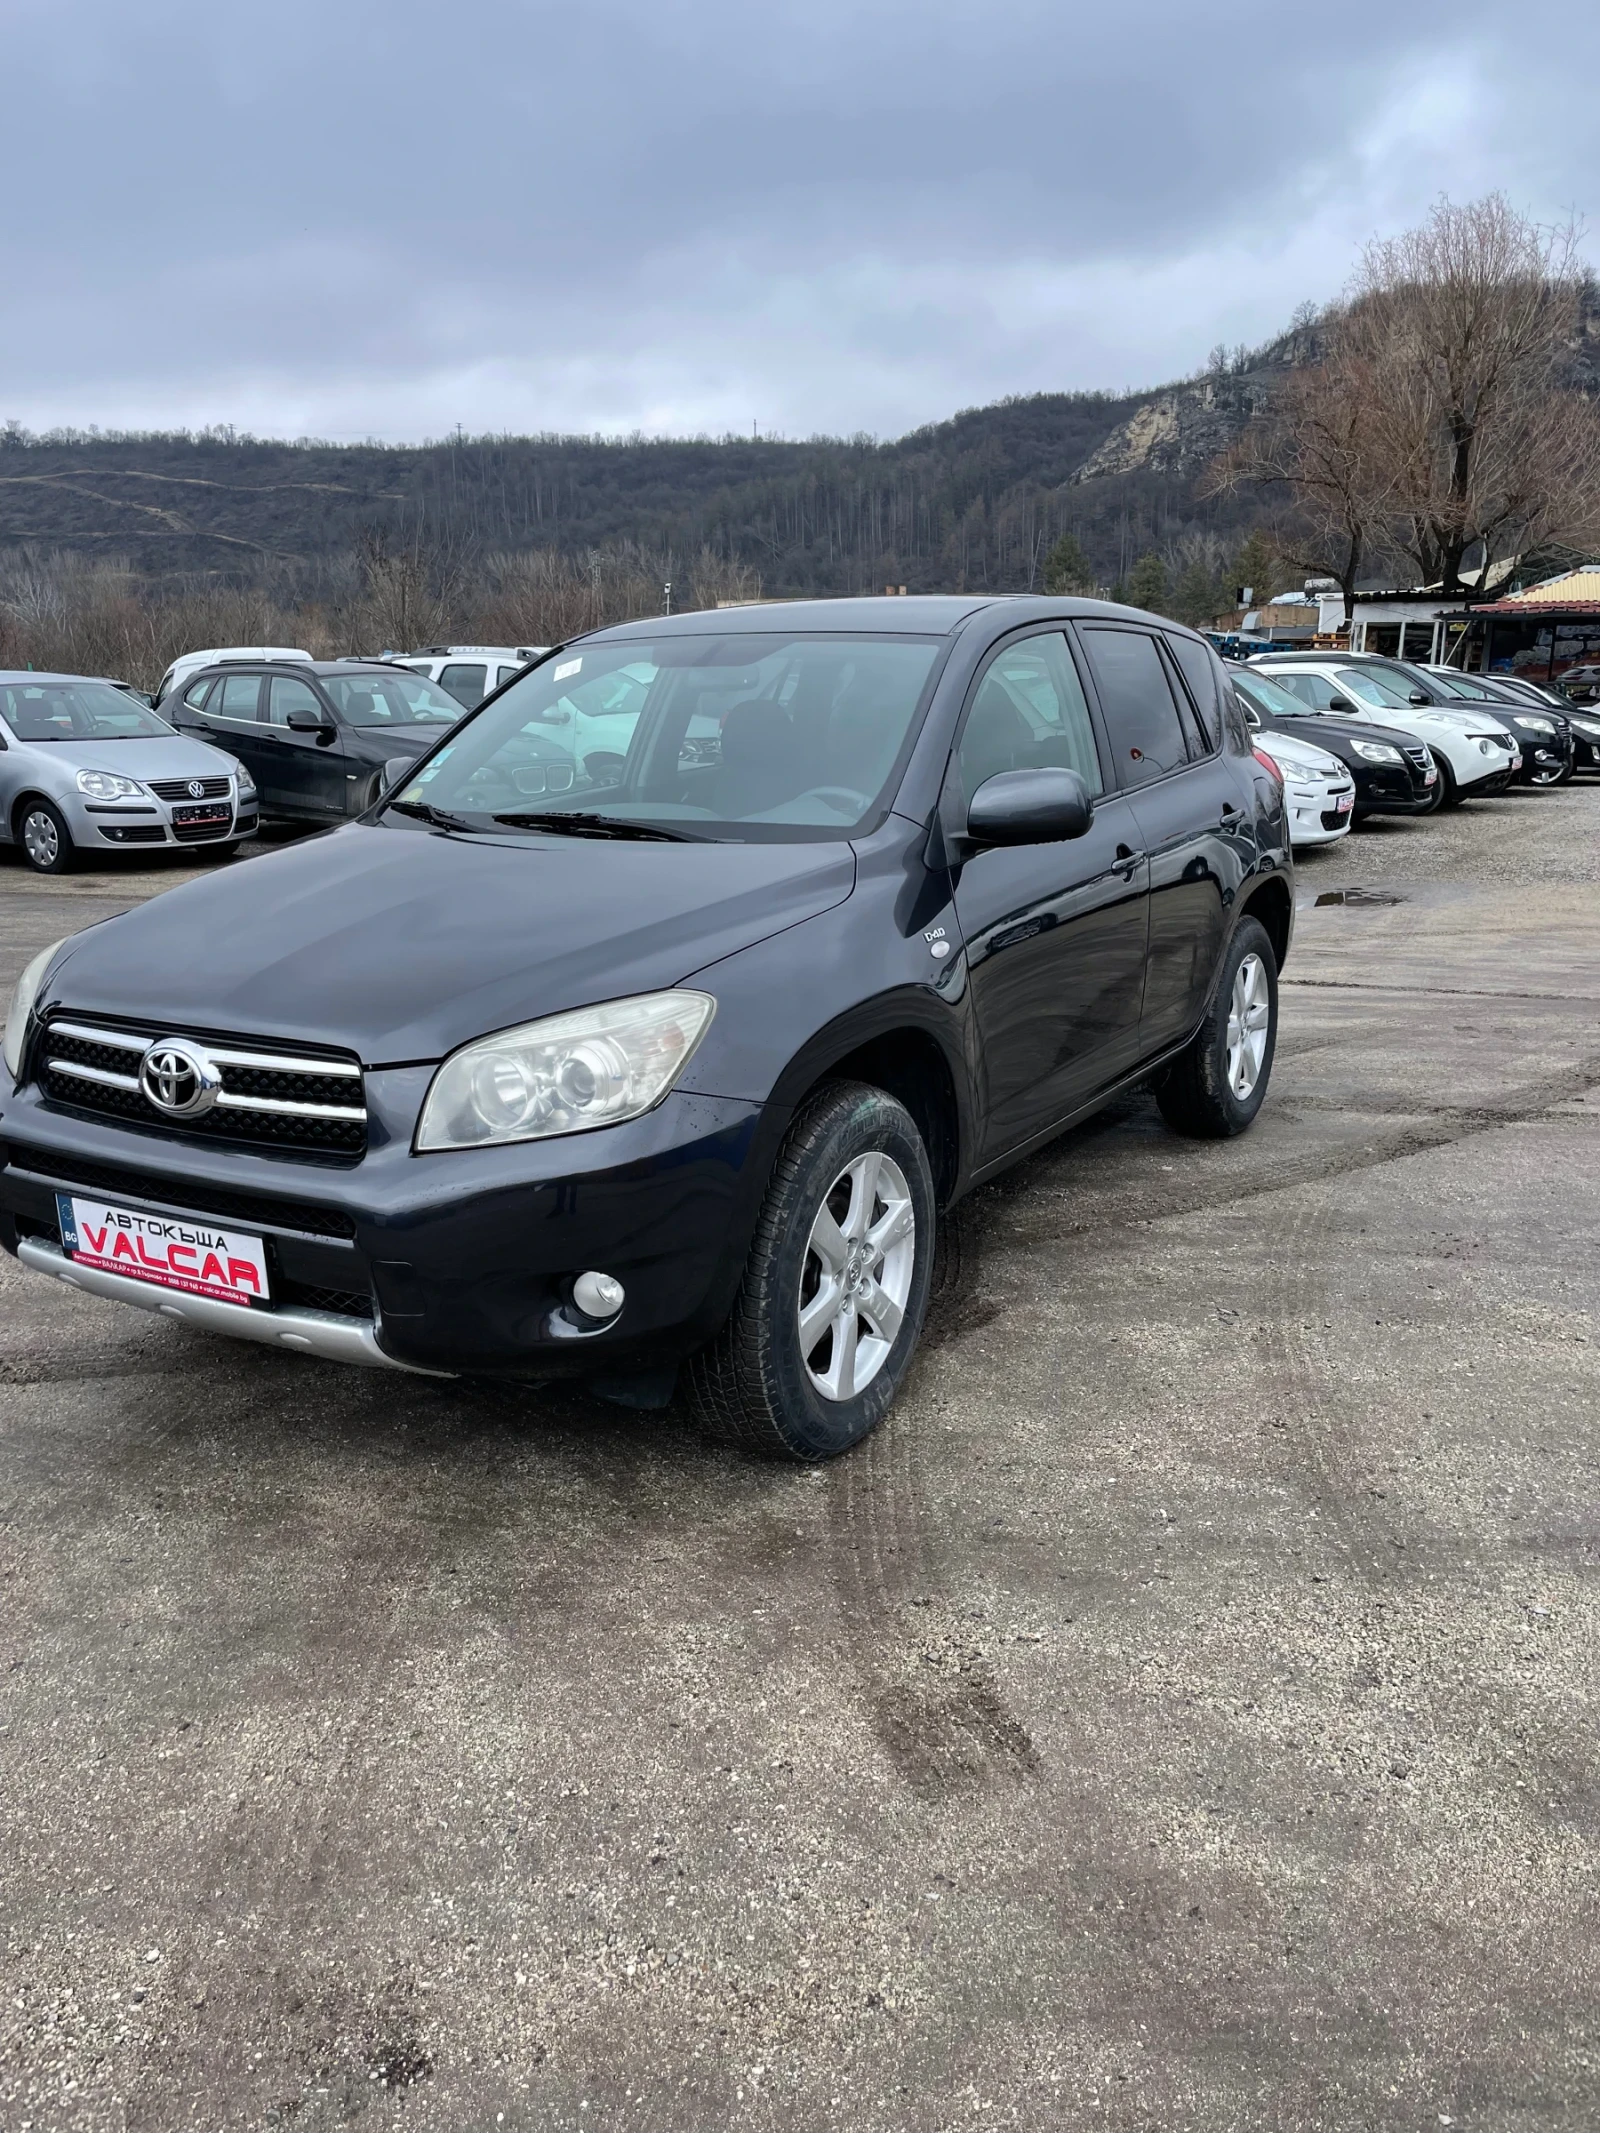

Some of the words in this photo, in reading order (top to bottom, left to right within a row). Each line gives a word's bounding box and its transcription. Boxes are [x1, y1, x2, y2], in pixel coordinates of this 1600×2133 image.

[64, 1231, 78, 1243] BG
[104, 1211, 229, 1252] АВТОКЪЩА
[81, 1222, 261, 1294] VALCAR
